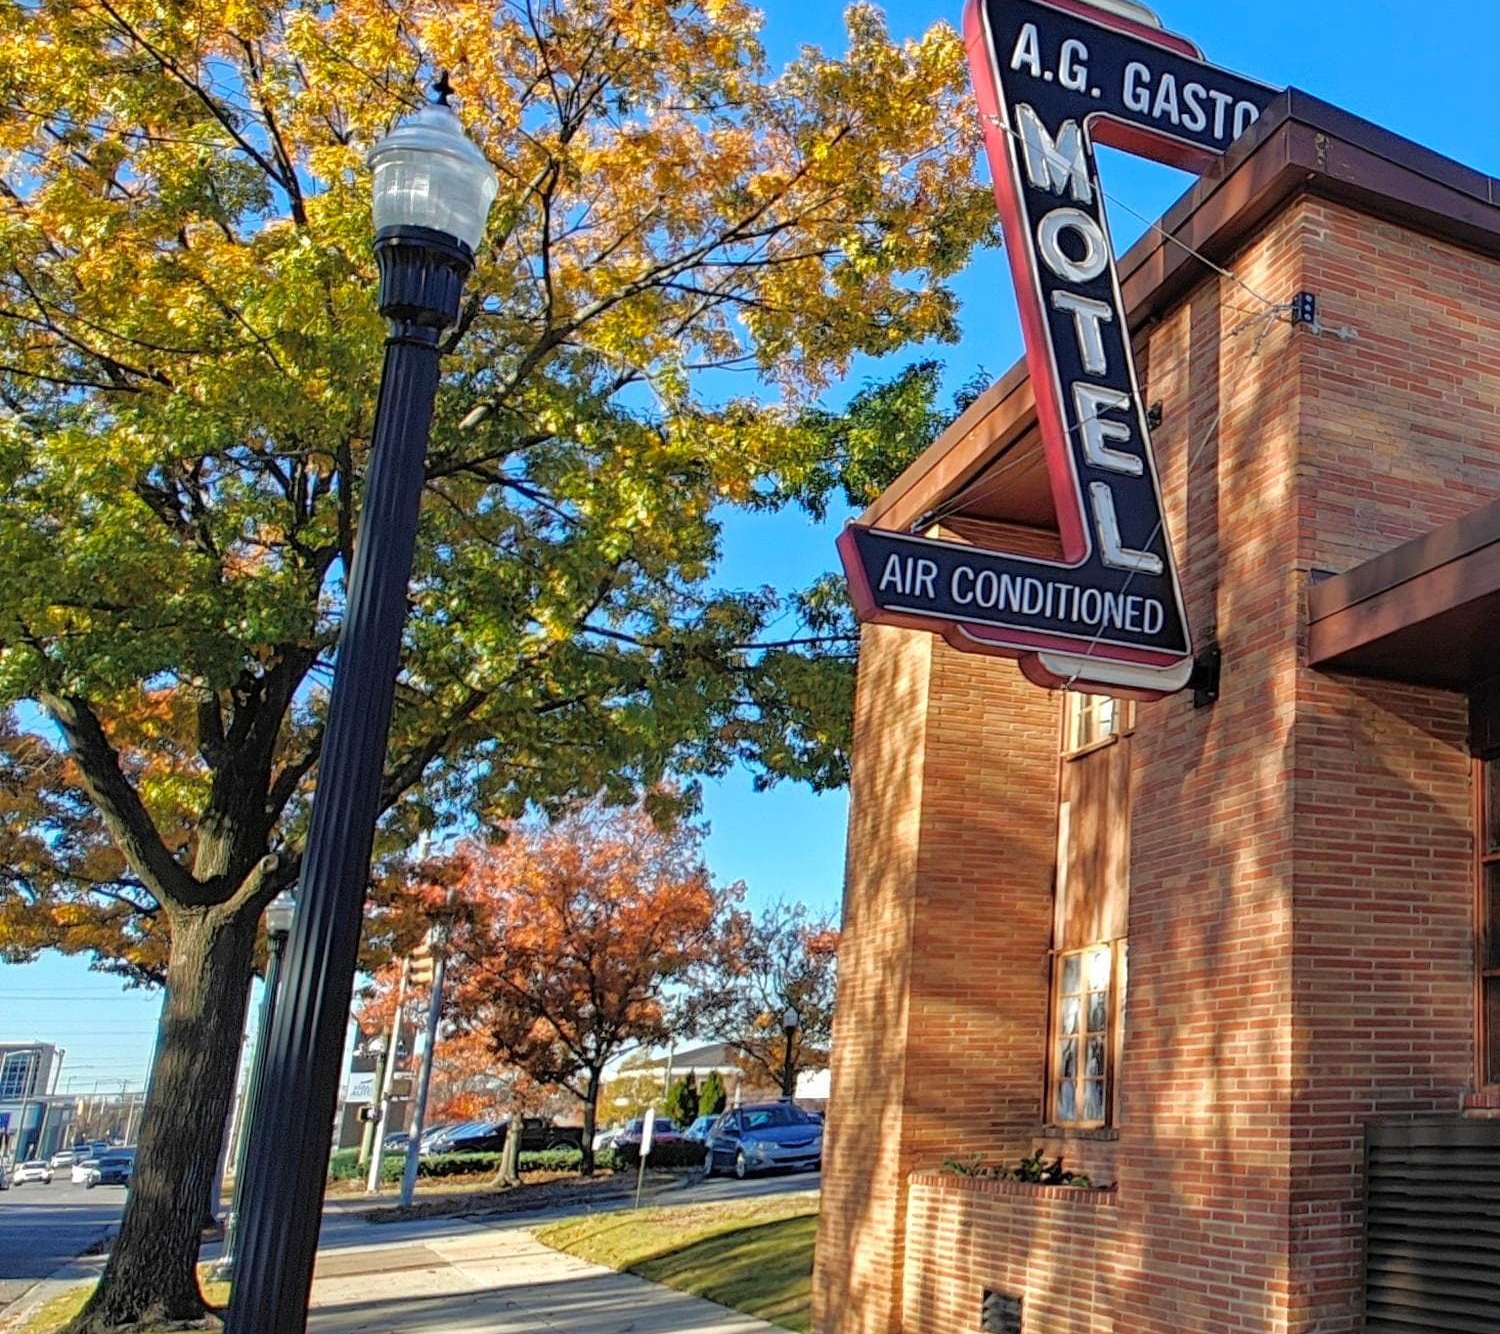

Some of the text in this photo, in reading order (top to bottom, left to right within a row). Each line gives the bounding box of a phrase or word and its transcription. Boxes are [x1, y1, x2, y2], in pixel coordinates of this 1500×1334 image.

[1010, 22, 1102, 99] A.G.
[1014, 102, 1163, 575] MOTEL
[879, 553, 1163, 635] AIR CONDITIONED
